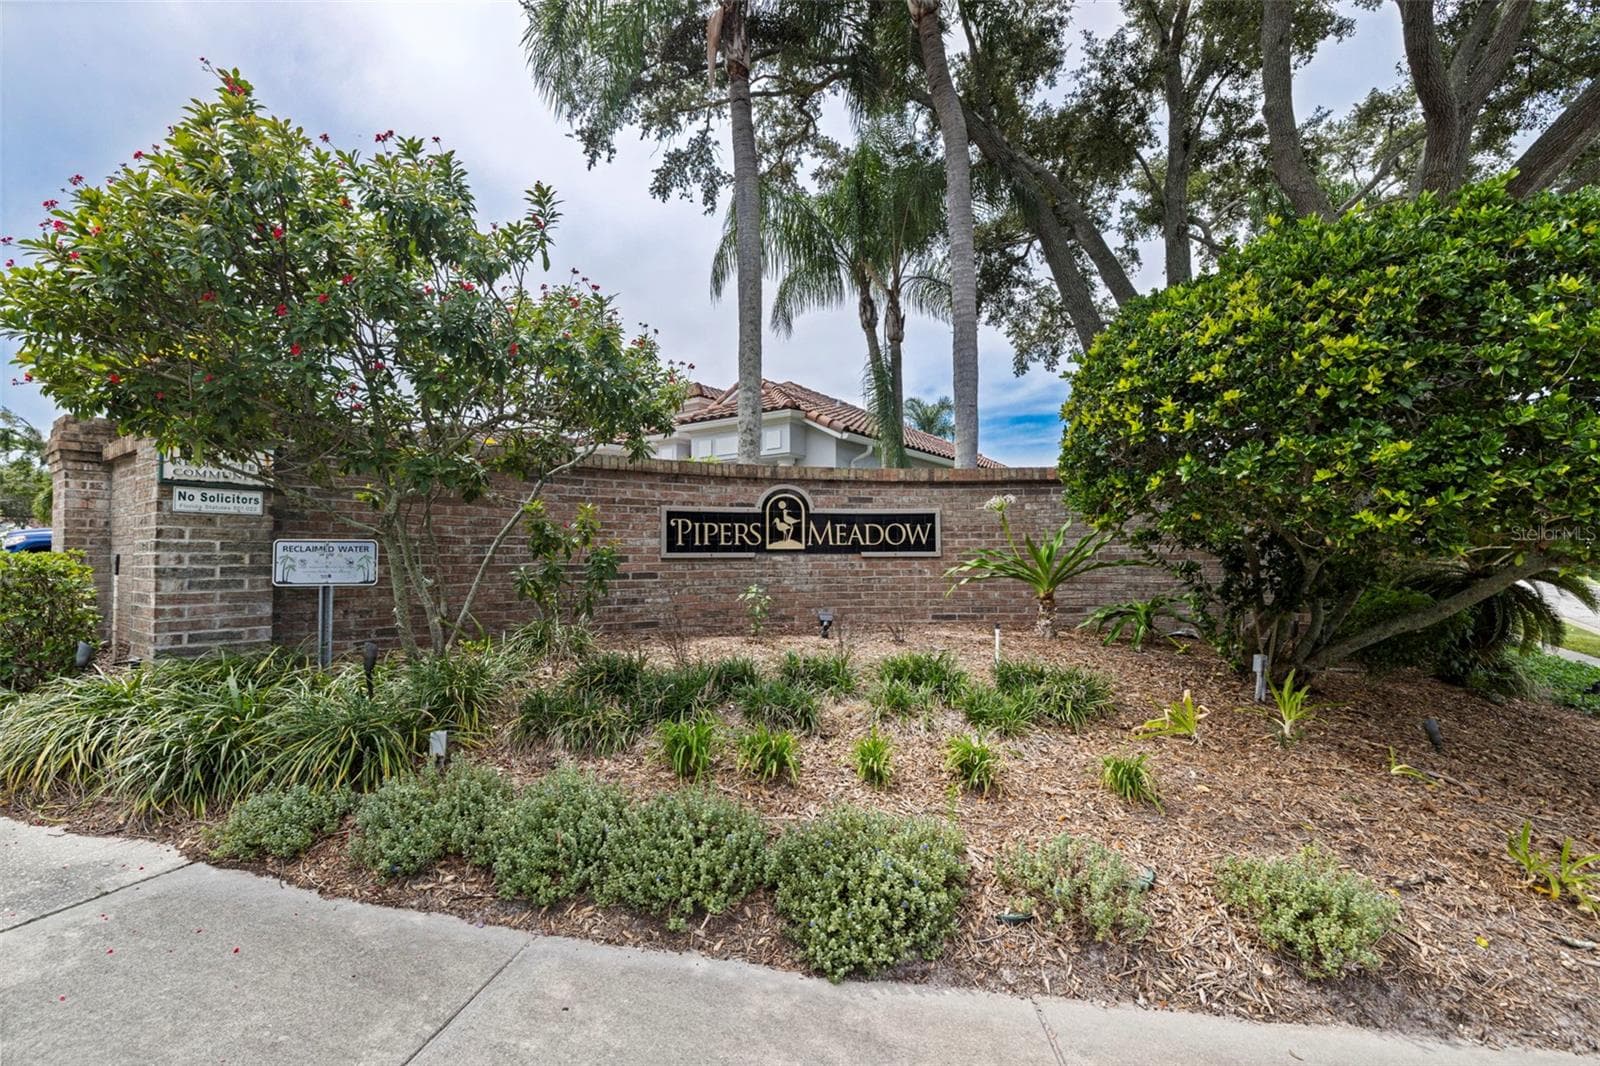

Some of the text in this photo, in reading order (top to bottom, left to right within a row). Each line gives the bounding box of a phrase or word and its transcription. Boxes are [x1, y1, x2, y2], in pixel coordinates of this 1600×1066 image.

[178, 490, 260, 505] No Solicitors
[670, 518, 932, 546] PIPERS MEADOW
[282, 545, 370, 553] RECLAIMED WATER
